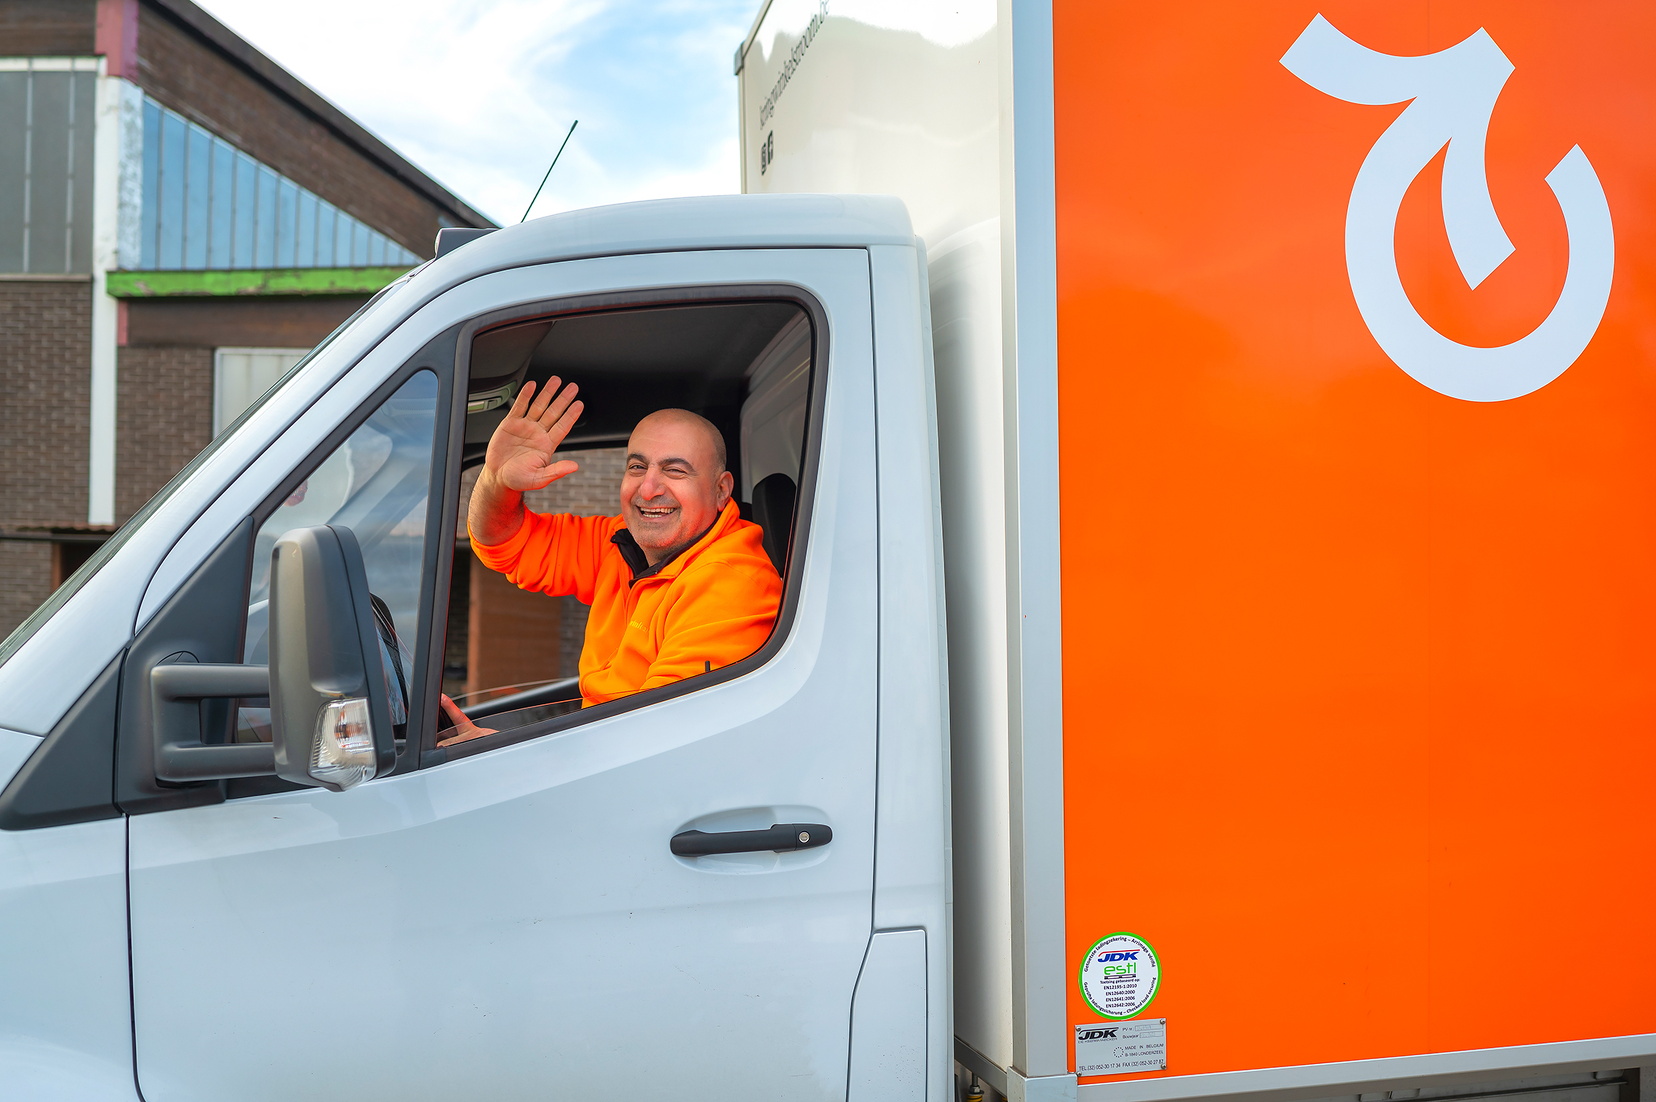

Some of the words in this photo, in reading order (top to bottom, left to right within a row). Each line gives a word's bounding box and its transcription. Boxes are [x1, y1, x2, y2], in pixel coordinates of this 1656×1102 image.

[1097, 951, 1139, 963] JDK
[1103, 962, 1136, 975] estl
[1078, 1030, 1118, 1040] JDK
